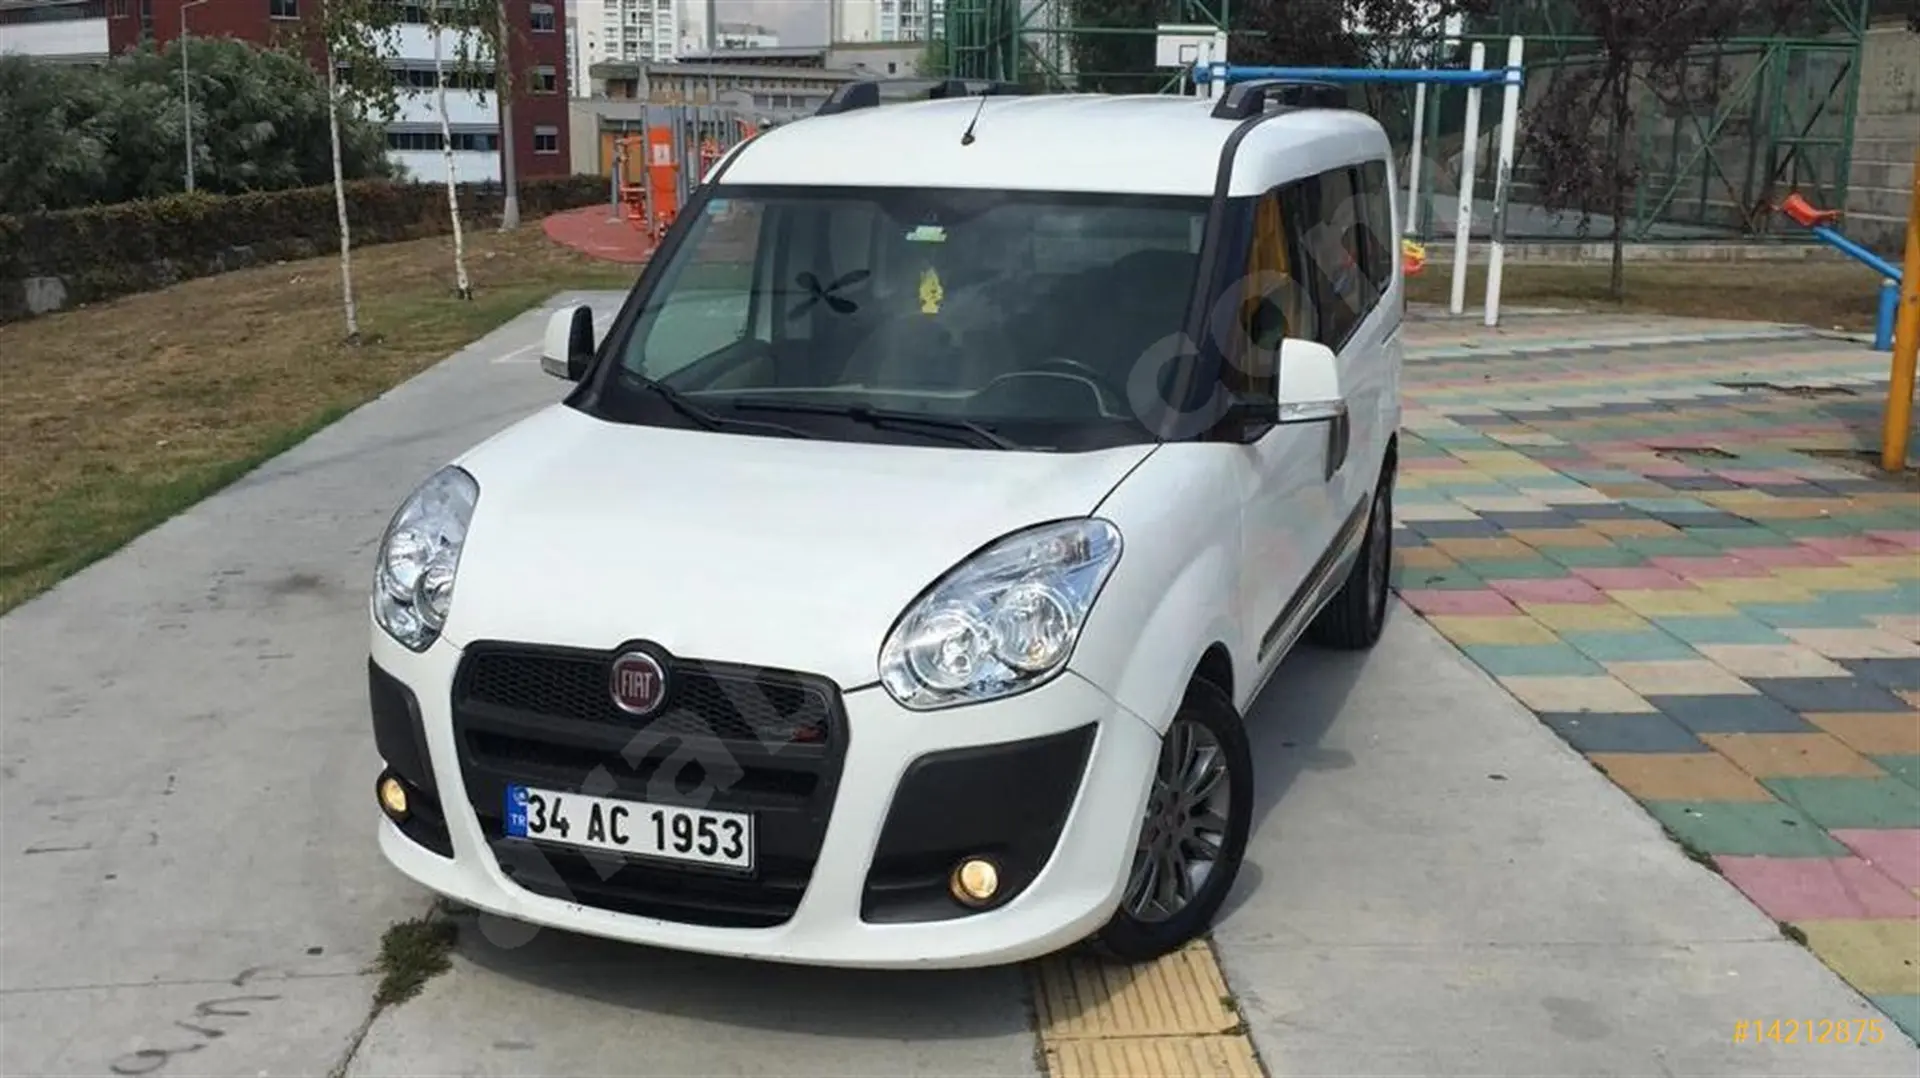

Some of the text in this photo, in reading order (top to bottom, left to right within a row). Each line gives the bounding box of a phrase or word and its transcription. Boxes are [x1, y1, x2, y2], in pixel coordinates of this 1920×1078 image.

[621, 669, 652, 699] FIAT
[527, 794, 743, 859] 34 AC 1953
